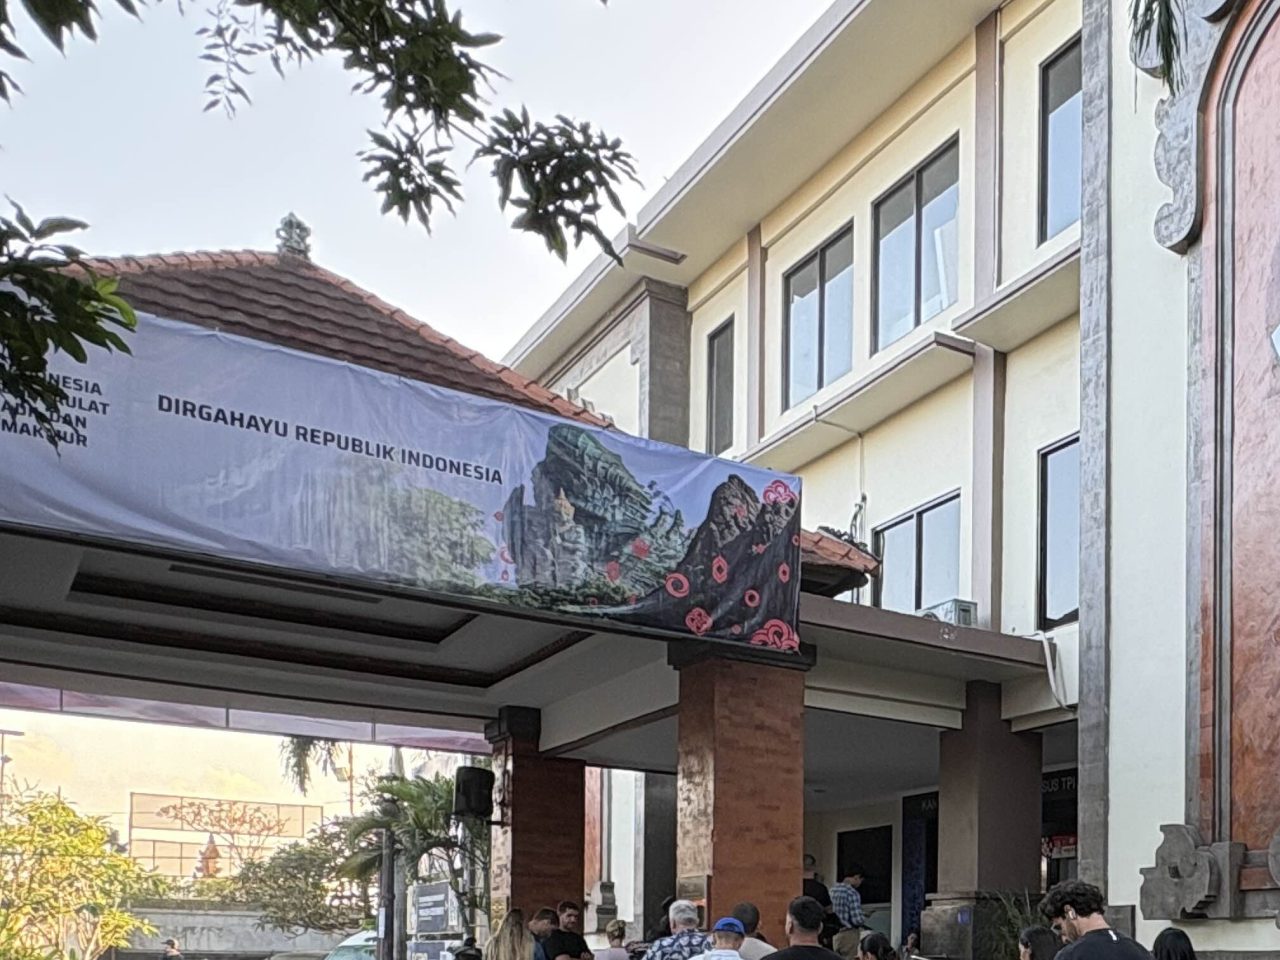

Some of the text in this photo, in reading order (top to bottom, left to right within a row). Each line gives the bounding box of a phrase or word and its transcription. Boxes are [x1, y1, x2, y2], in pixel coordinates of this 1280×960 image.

[157, 394, 503, 485] DIRGAHAYU REPUBLIK INDONESIA
